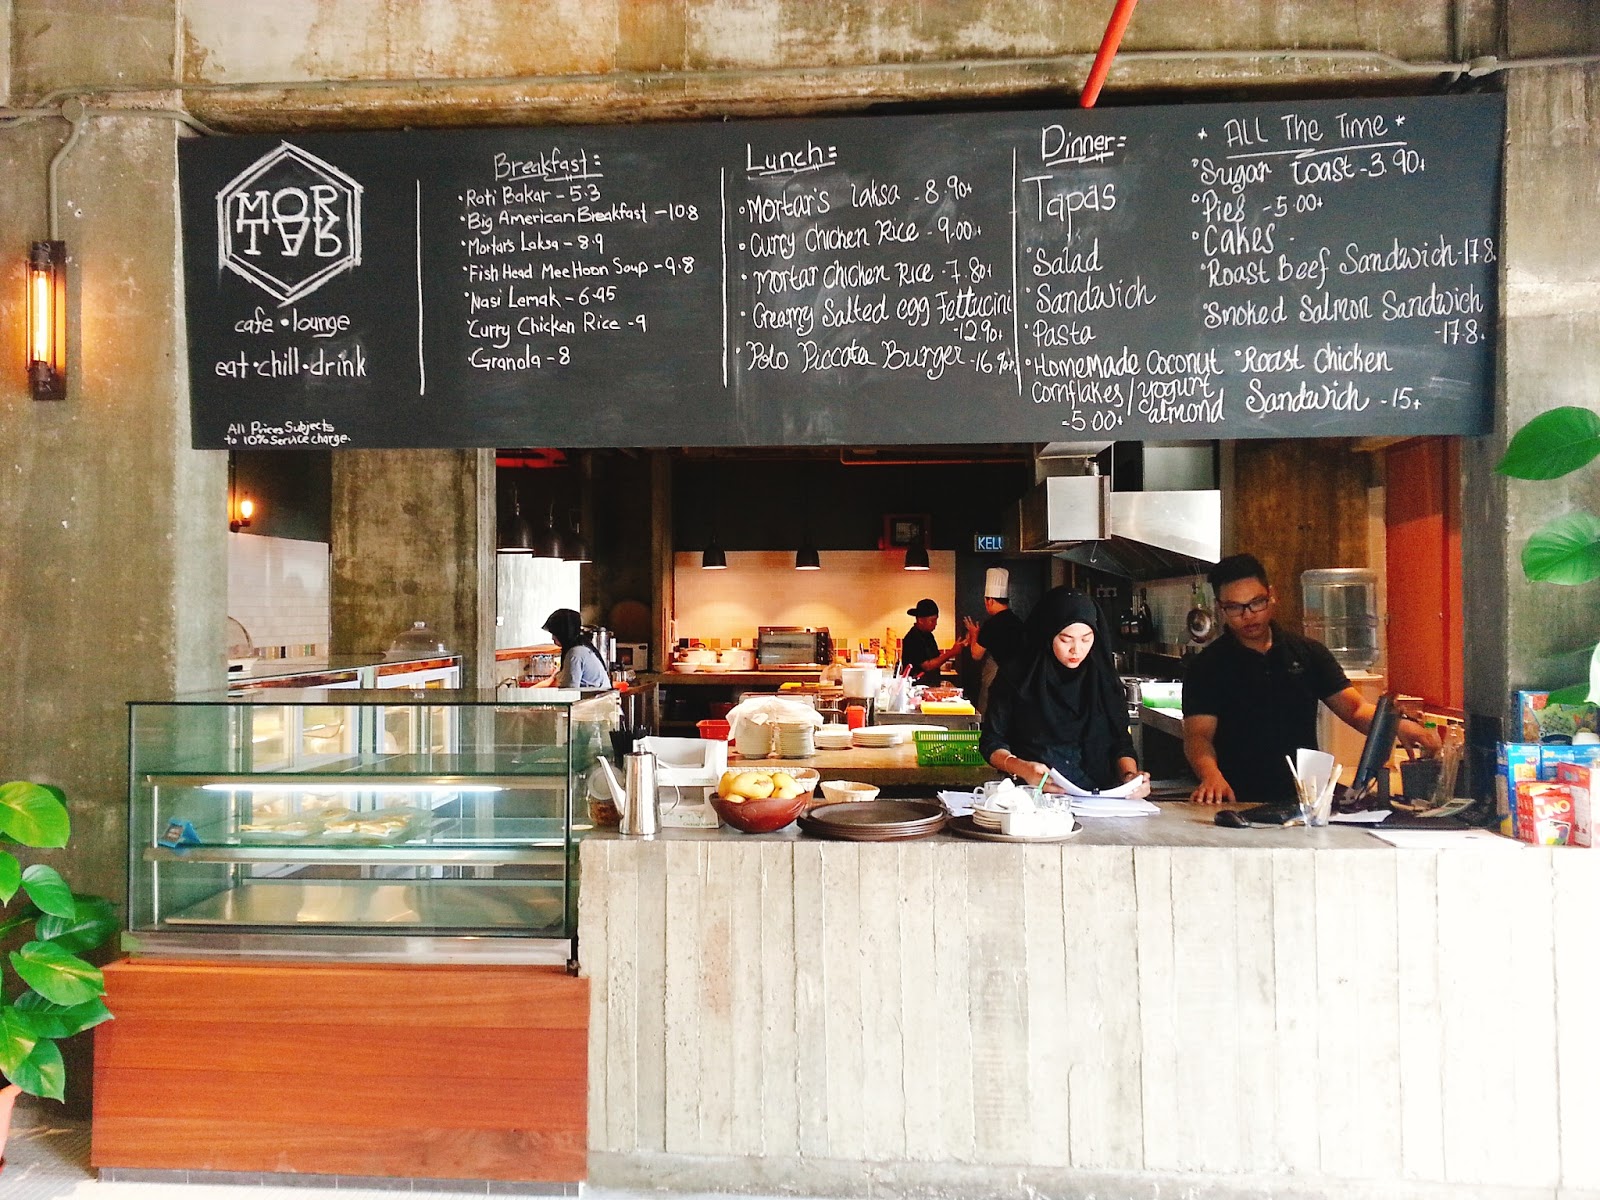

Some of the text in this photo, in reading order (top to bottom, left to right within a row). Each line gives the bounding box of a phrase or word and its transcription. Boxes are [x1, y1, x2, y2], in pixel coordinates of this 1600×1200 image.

[1281, 114, 1323, 142] The
[1200, 158, 1272, 193] Sugar
[466, 189, 497, 207] Roti
[1021, 174, 1116, 242] Tapas
[1202, 189, 1245, 222] Pies
[468, 212, 493, 235] Big
[499, 209, 575, 226] American
[577, 202, 647, 224] Breakfast
[875, 218, 920, 246] Rice
[521, 231, 559, 251] Laksa
[1204, 223, 1275, 256] Cakes
[469, 263, 499, 282] Fish
[503, 263, 533, 280] Head
[613, 257, 649, 278] Soup
[1033, 237, 1104, 276] Salad
[1207, 258, 1270, 288] Roast
[1278, 247, 1330, 289] Beef
[1339, 233, 1457, 275] Sandwich
[471, 289, 501, 314] Nasi
[509, 285, 562, 308] Lemak
[1036, 275, 1156, 314] Sandwich
[1204, 282, 1483, 328] Smoked Salmon Sandwich
[234, 306, 350, 338] cafe lounge
[468, 320, 511, 348] Curry
[517, 314, 575, 337] Chicken
[583, 312, 621, 332] Rice
[753, 302, 814, 336] Creamy
[822, 293, 889, 328] Salted
[897, 296, 930, 326] egg
[1033, 319, 1097, 347] Pasta
[215, 344, 367, 379] eat chill drink
[471, 344, 541, 371] Granola
[881, 340, 965, 380] Burger
[1147, 348, 1224, 375] Coconut
[1241, 344, 1305, 372] Roast
[1149, 388, 1225, 424] almond
[1246, 378, 1370, 413] Sandwich
[224, 435, 237, 445] to
[227, 424, 245, 435] All
[251, 421, 284, 435] Prices
